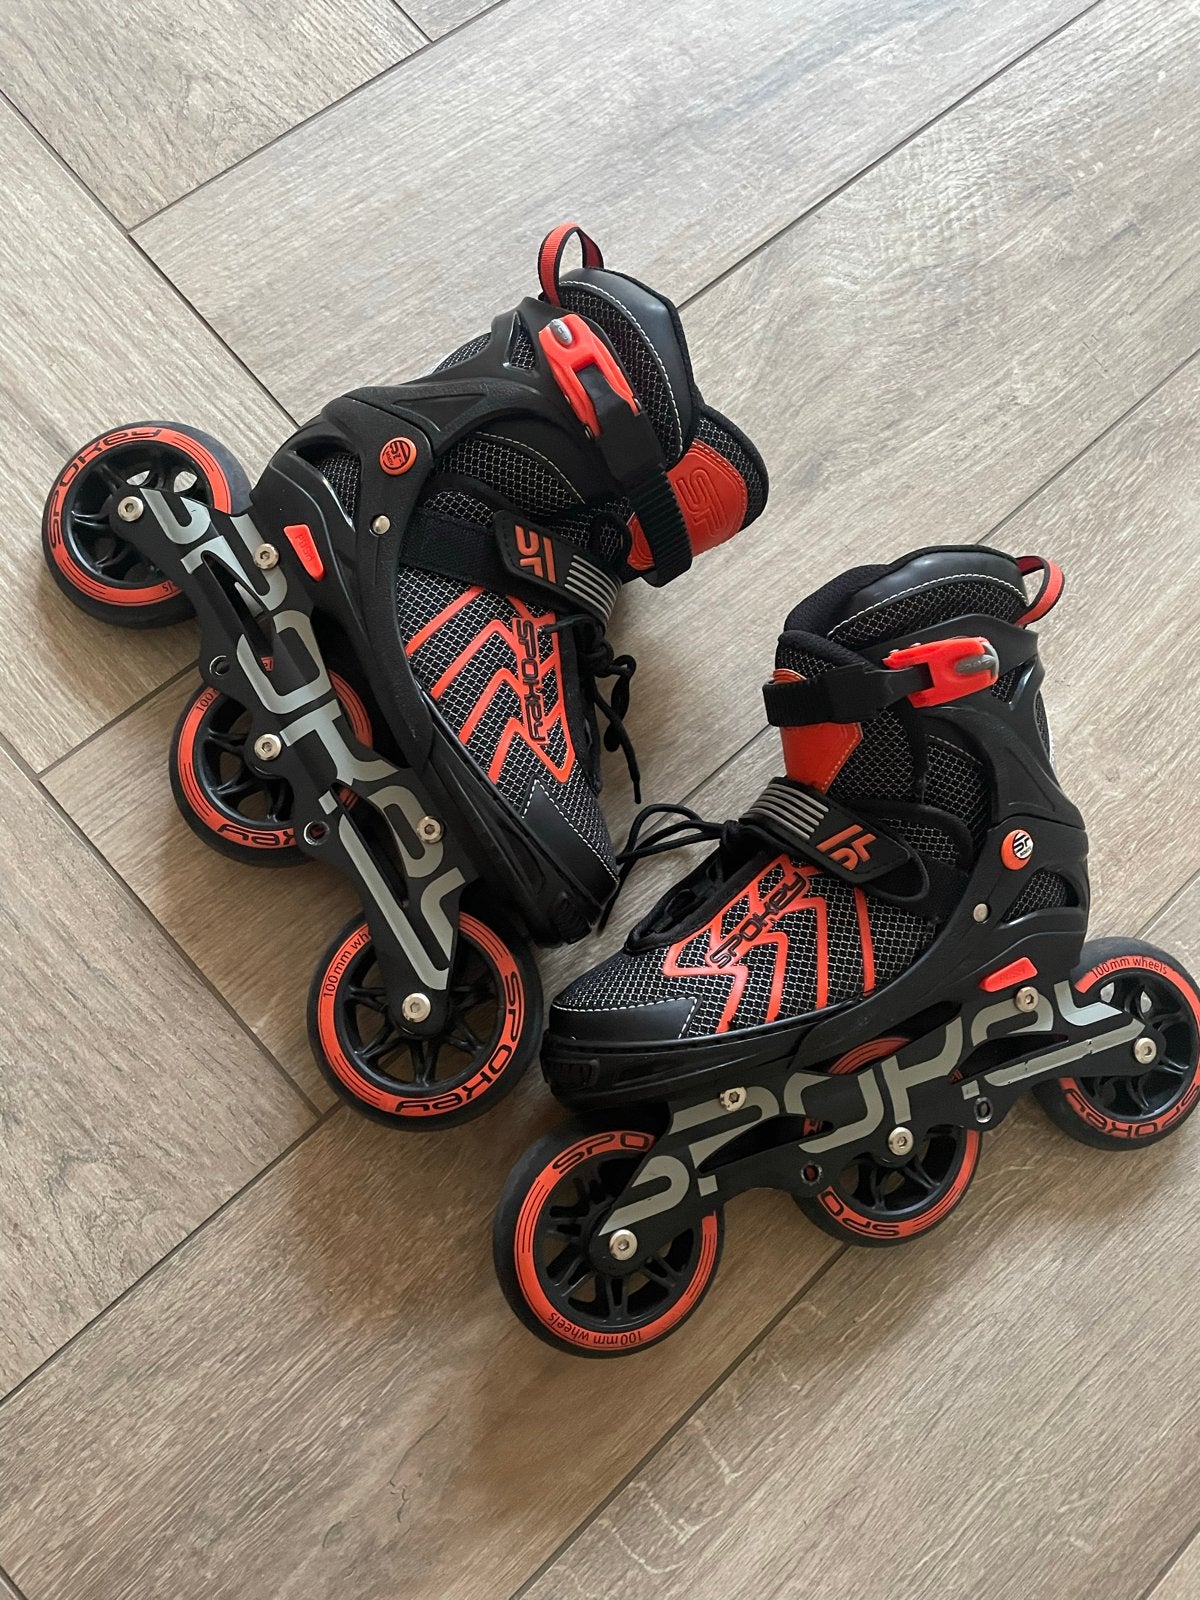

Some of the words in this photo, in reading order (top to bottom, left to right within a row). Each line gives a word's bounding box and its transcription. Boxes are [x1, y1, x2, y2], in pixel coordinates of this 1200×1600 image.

[323, 949, 352, 998] 100mm
[1091, 956, 1131, 979] 100mm
[1133, 956, 1168, 975] wheels
[549, 1312, 590, 1343] wheels
[593, 1329, 643, 1347] 100mm
